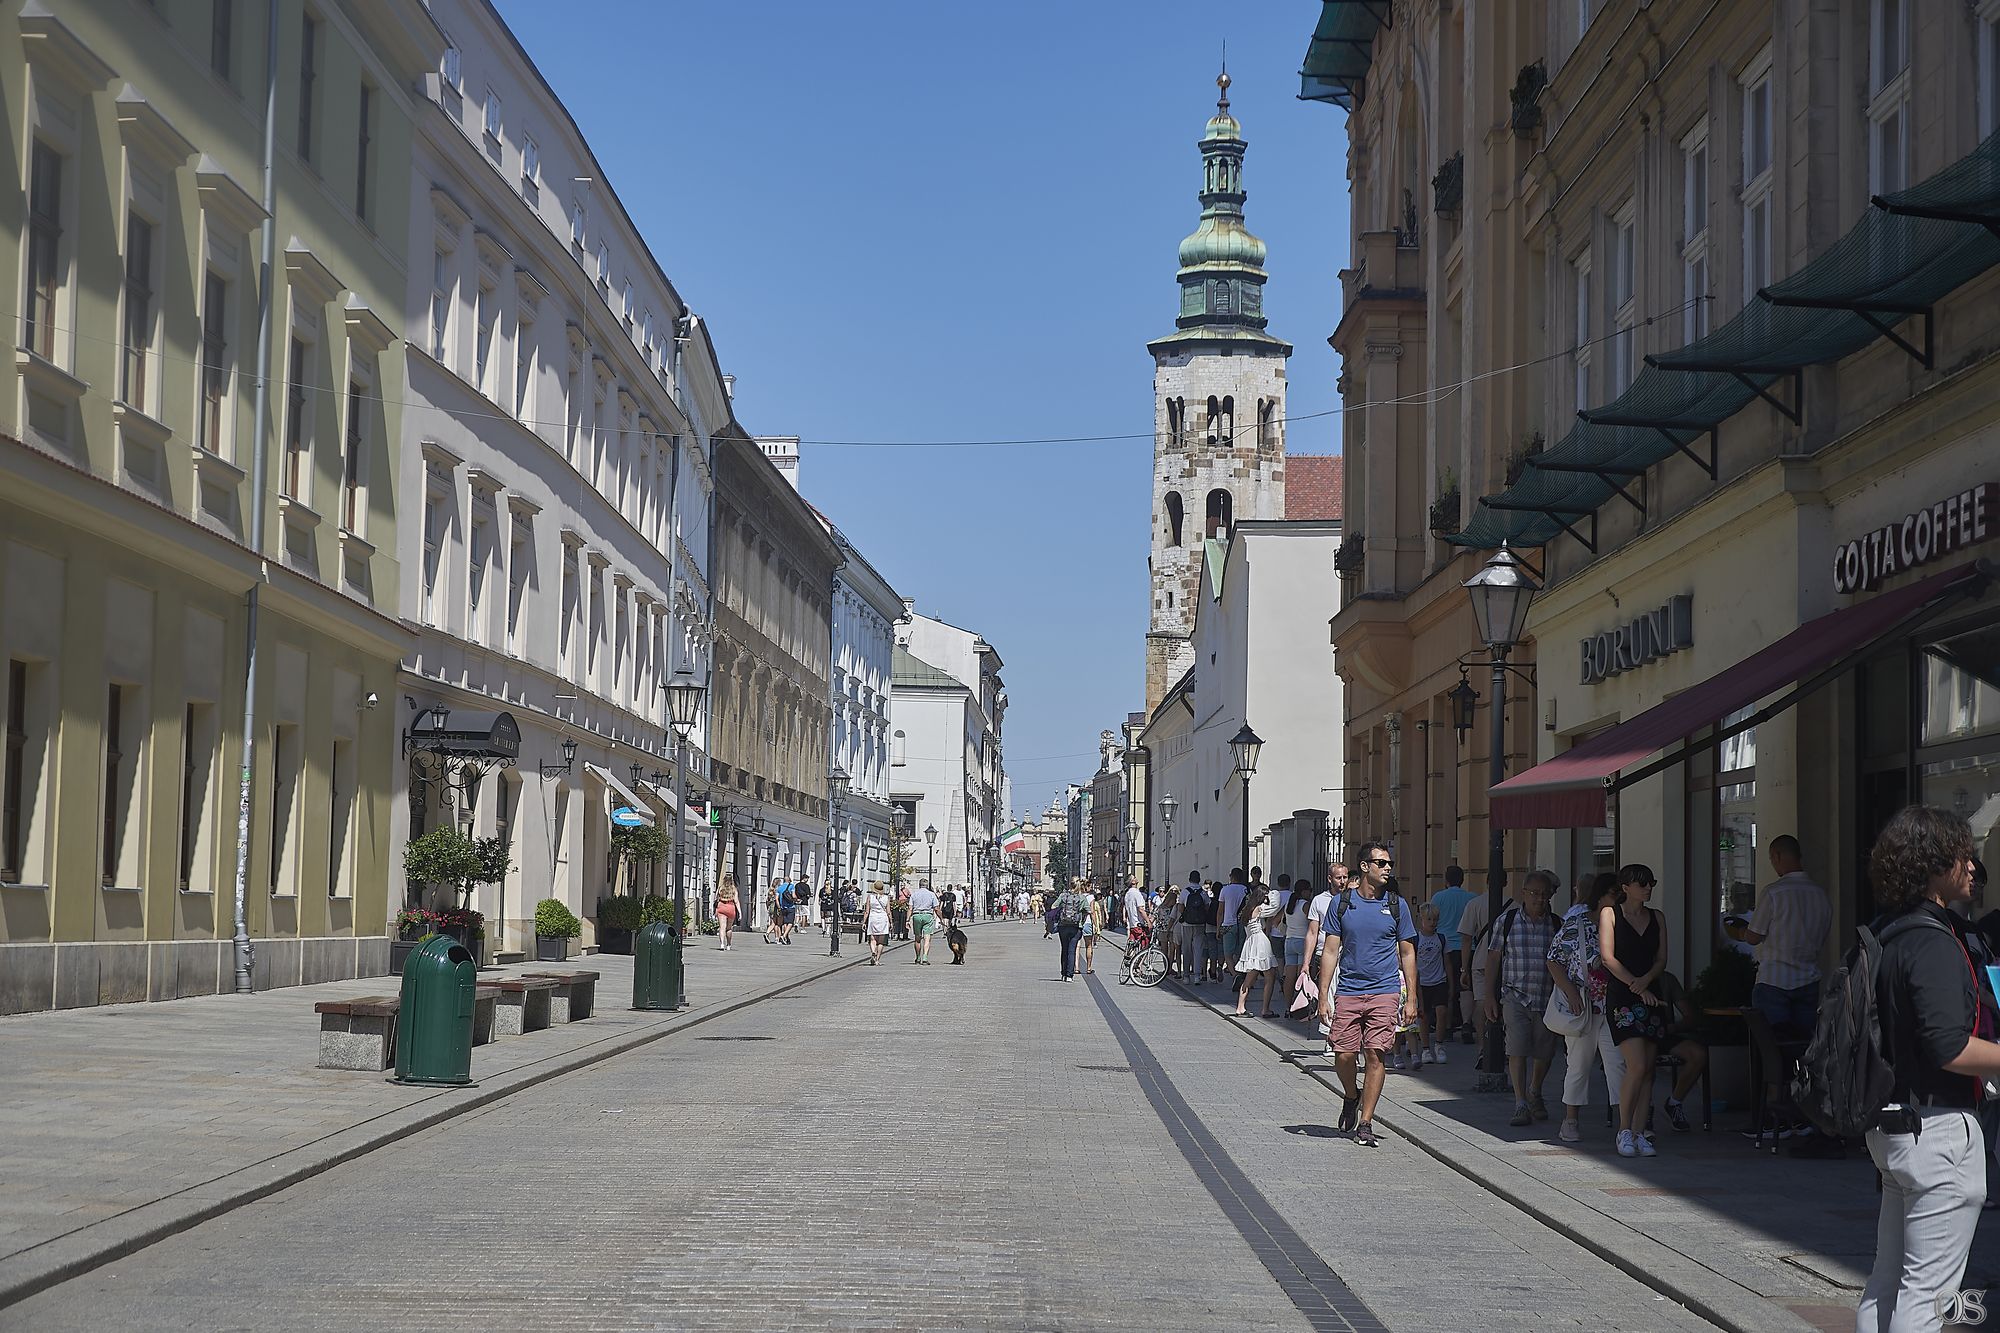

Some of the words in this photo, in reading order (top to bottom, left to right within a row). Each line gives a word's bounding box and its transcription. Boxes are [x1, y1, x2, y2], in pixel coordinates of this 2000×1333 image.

[1834, 524, 1896, 593] COSTA
[1901, 484, 1986, 567] COFFEE
[1579, 595, 1680, 685] BORUNI
